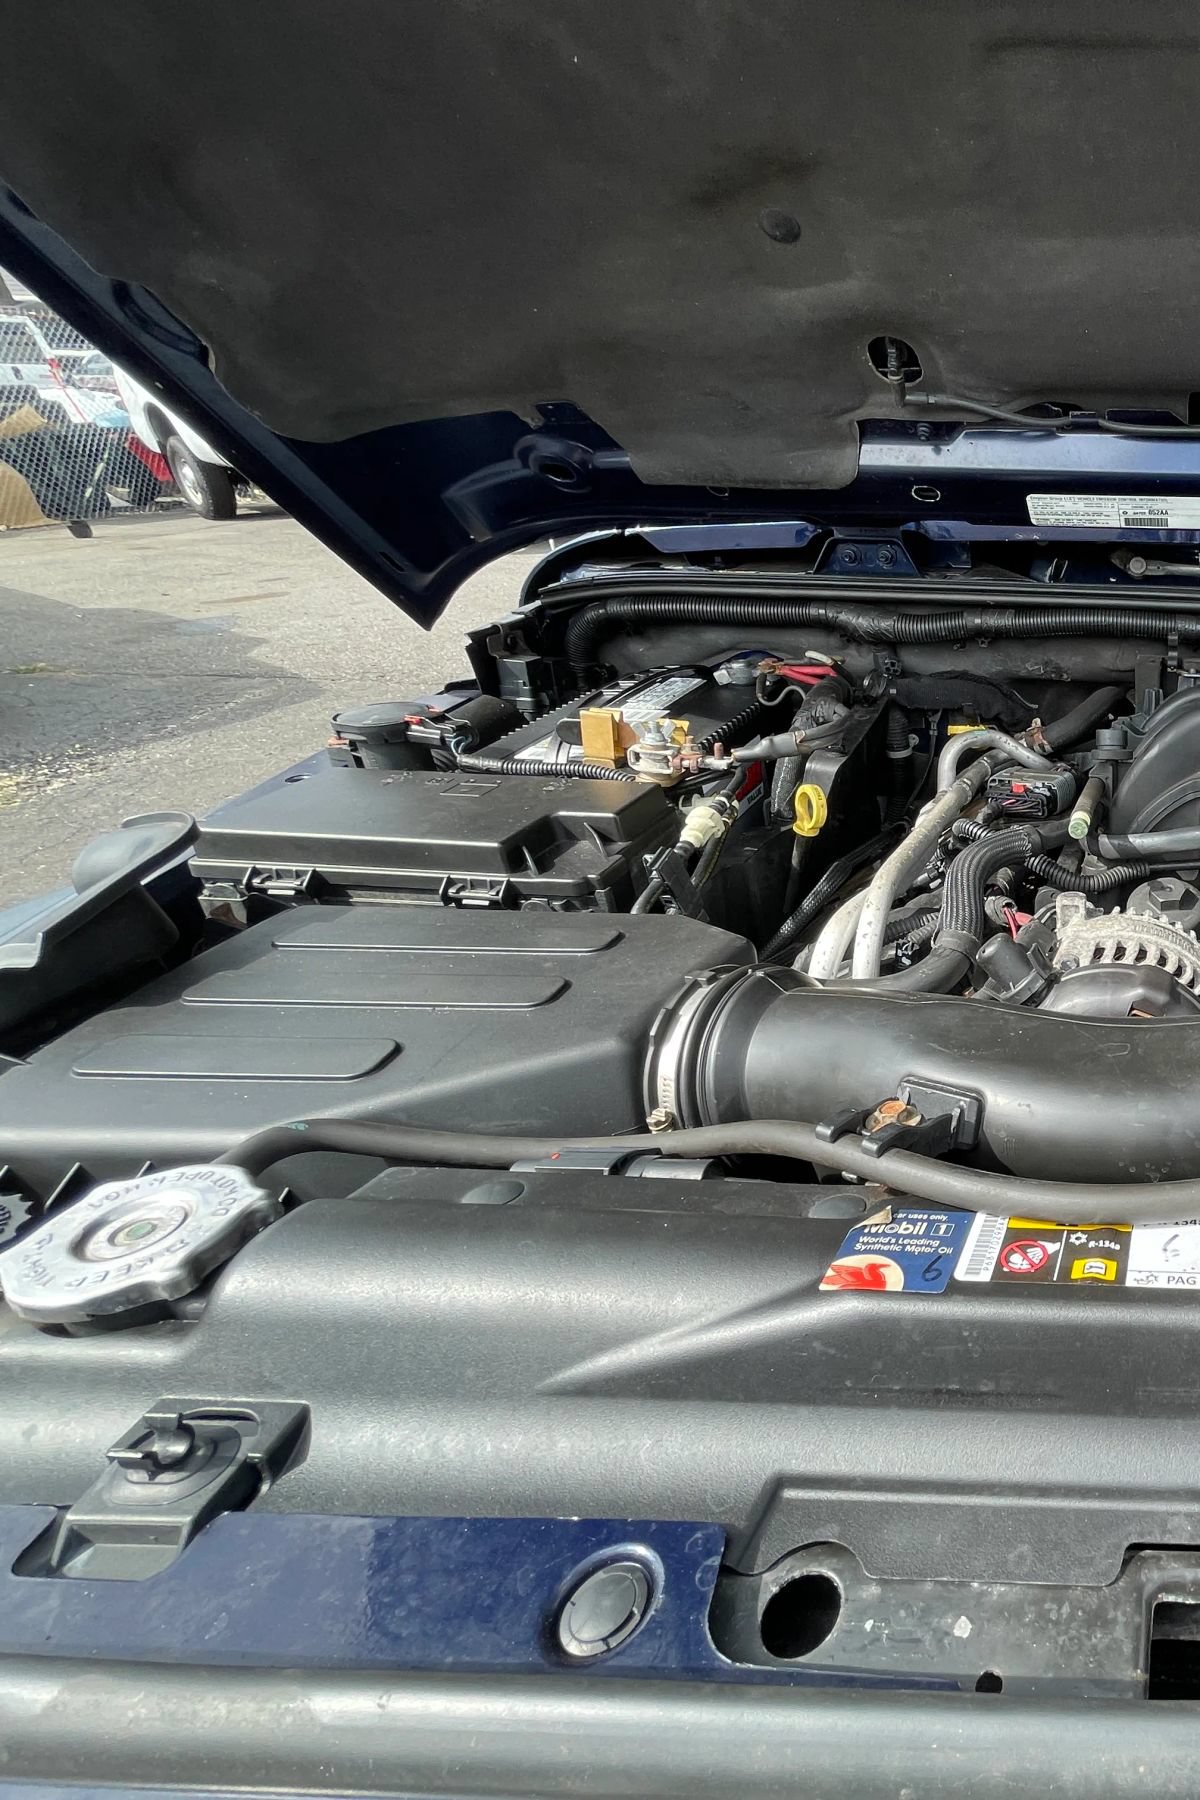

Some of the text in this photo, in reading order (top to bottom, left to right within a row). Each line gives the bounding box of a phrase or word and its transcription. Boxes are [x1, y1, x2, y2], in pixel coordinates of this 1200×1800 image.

[863, 1221, 928, 1236] Mobil
[859, 1236, 940, 1247] World's Leading
[854, 1243, 953, 1255] Synthetic Motor Oil
[922, 1254, 943, 1282] 6
[1167, 1275, 1197, 1285] PAG
